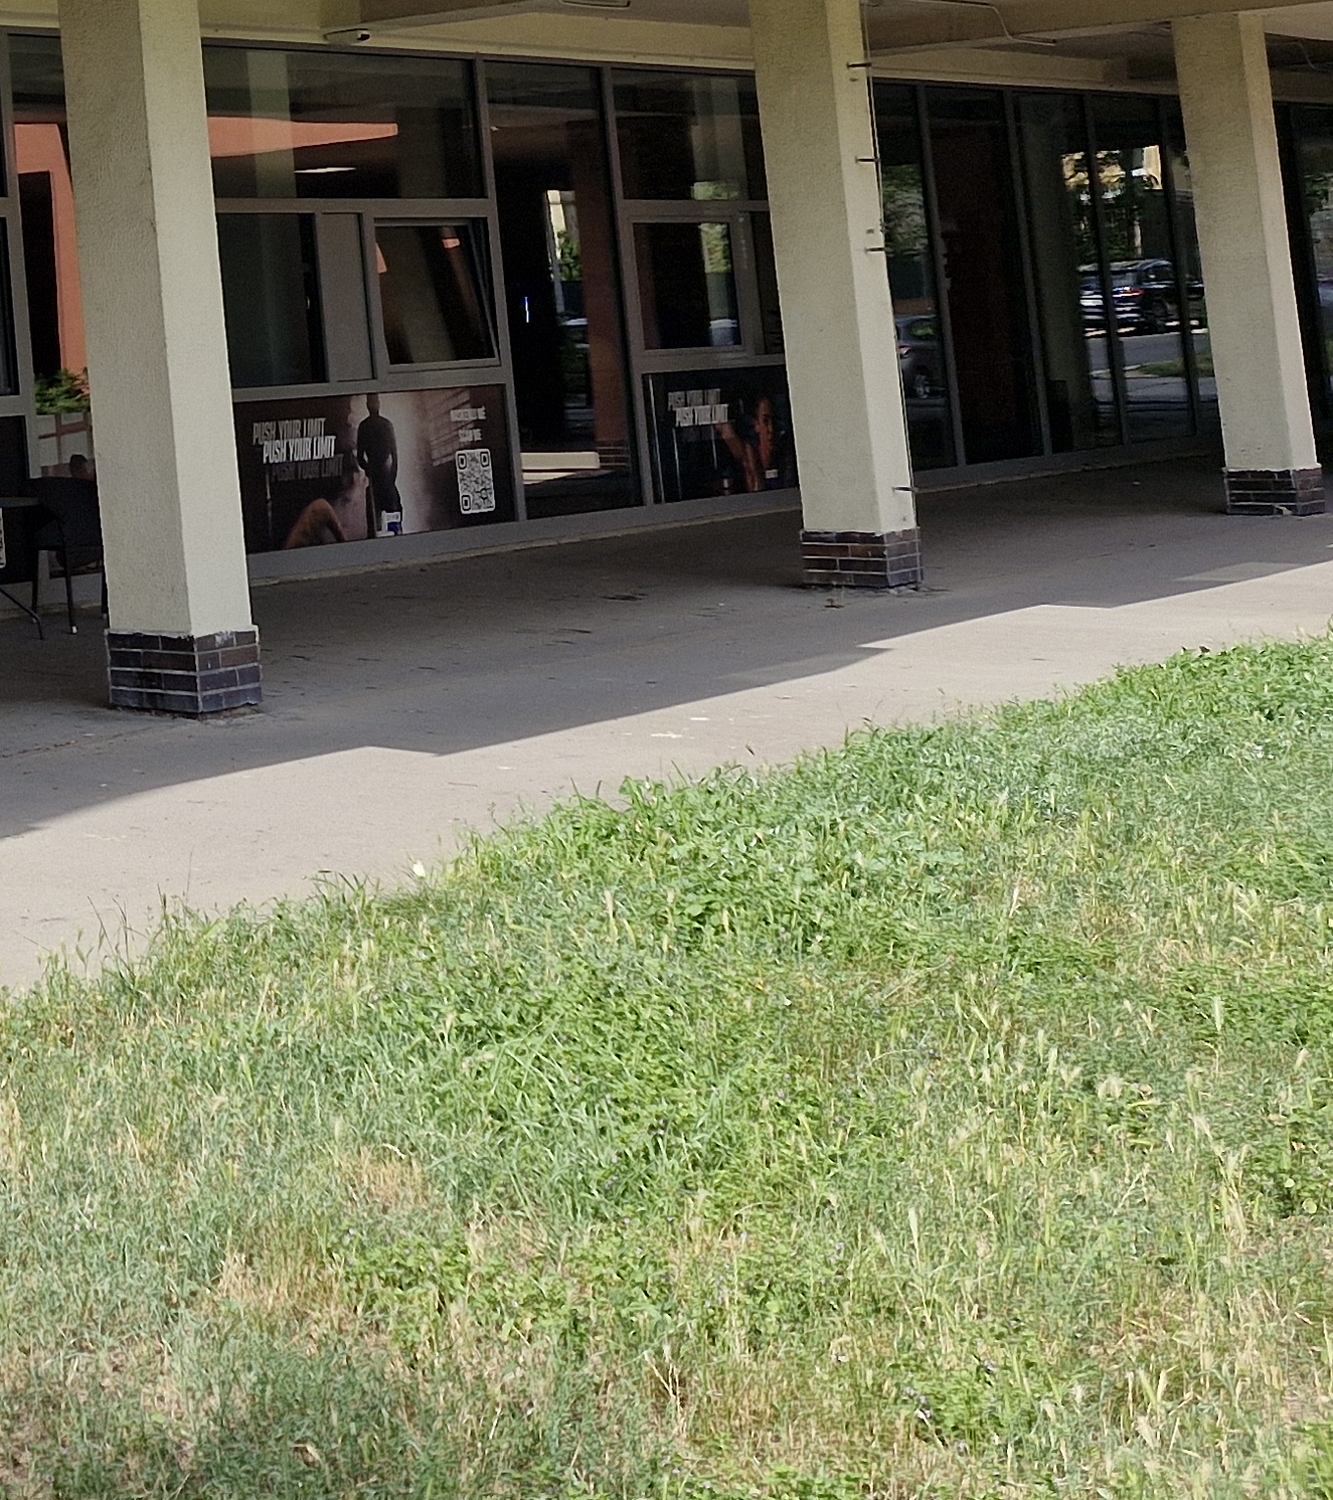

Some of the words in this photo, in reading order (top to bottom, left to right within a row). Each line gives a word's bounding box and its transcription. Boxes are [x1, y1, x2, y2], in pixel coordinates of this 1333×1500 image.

[253, 421, 276, 445] PUSH
[278, 419, 302, 440] YOUR
[303, 417, 326, 438] LIMIT
[263, 439, 287, 465] PUSH
[288, 437, 312, 462] YOUR
[313, 435, 336, 460] LIMIT
